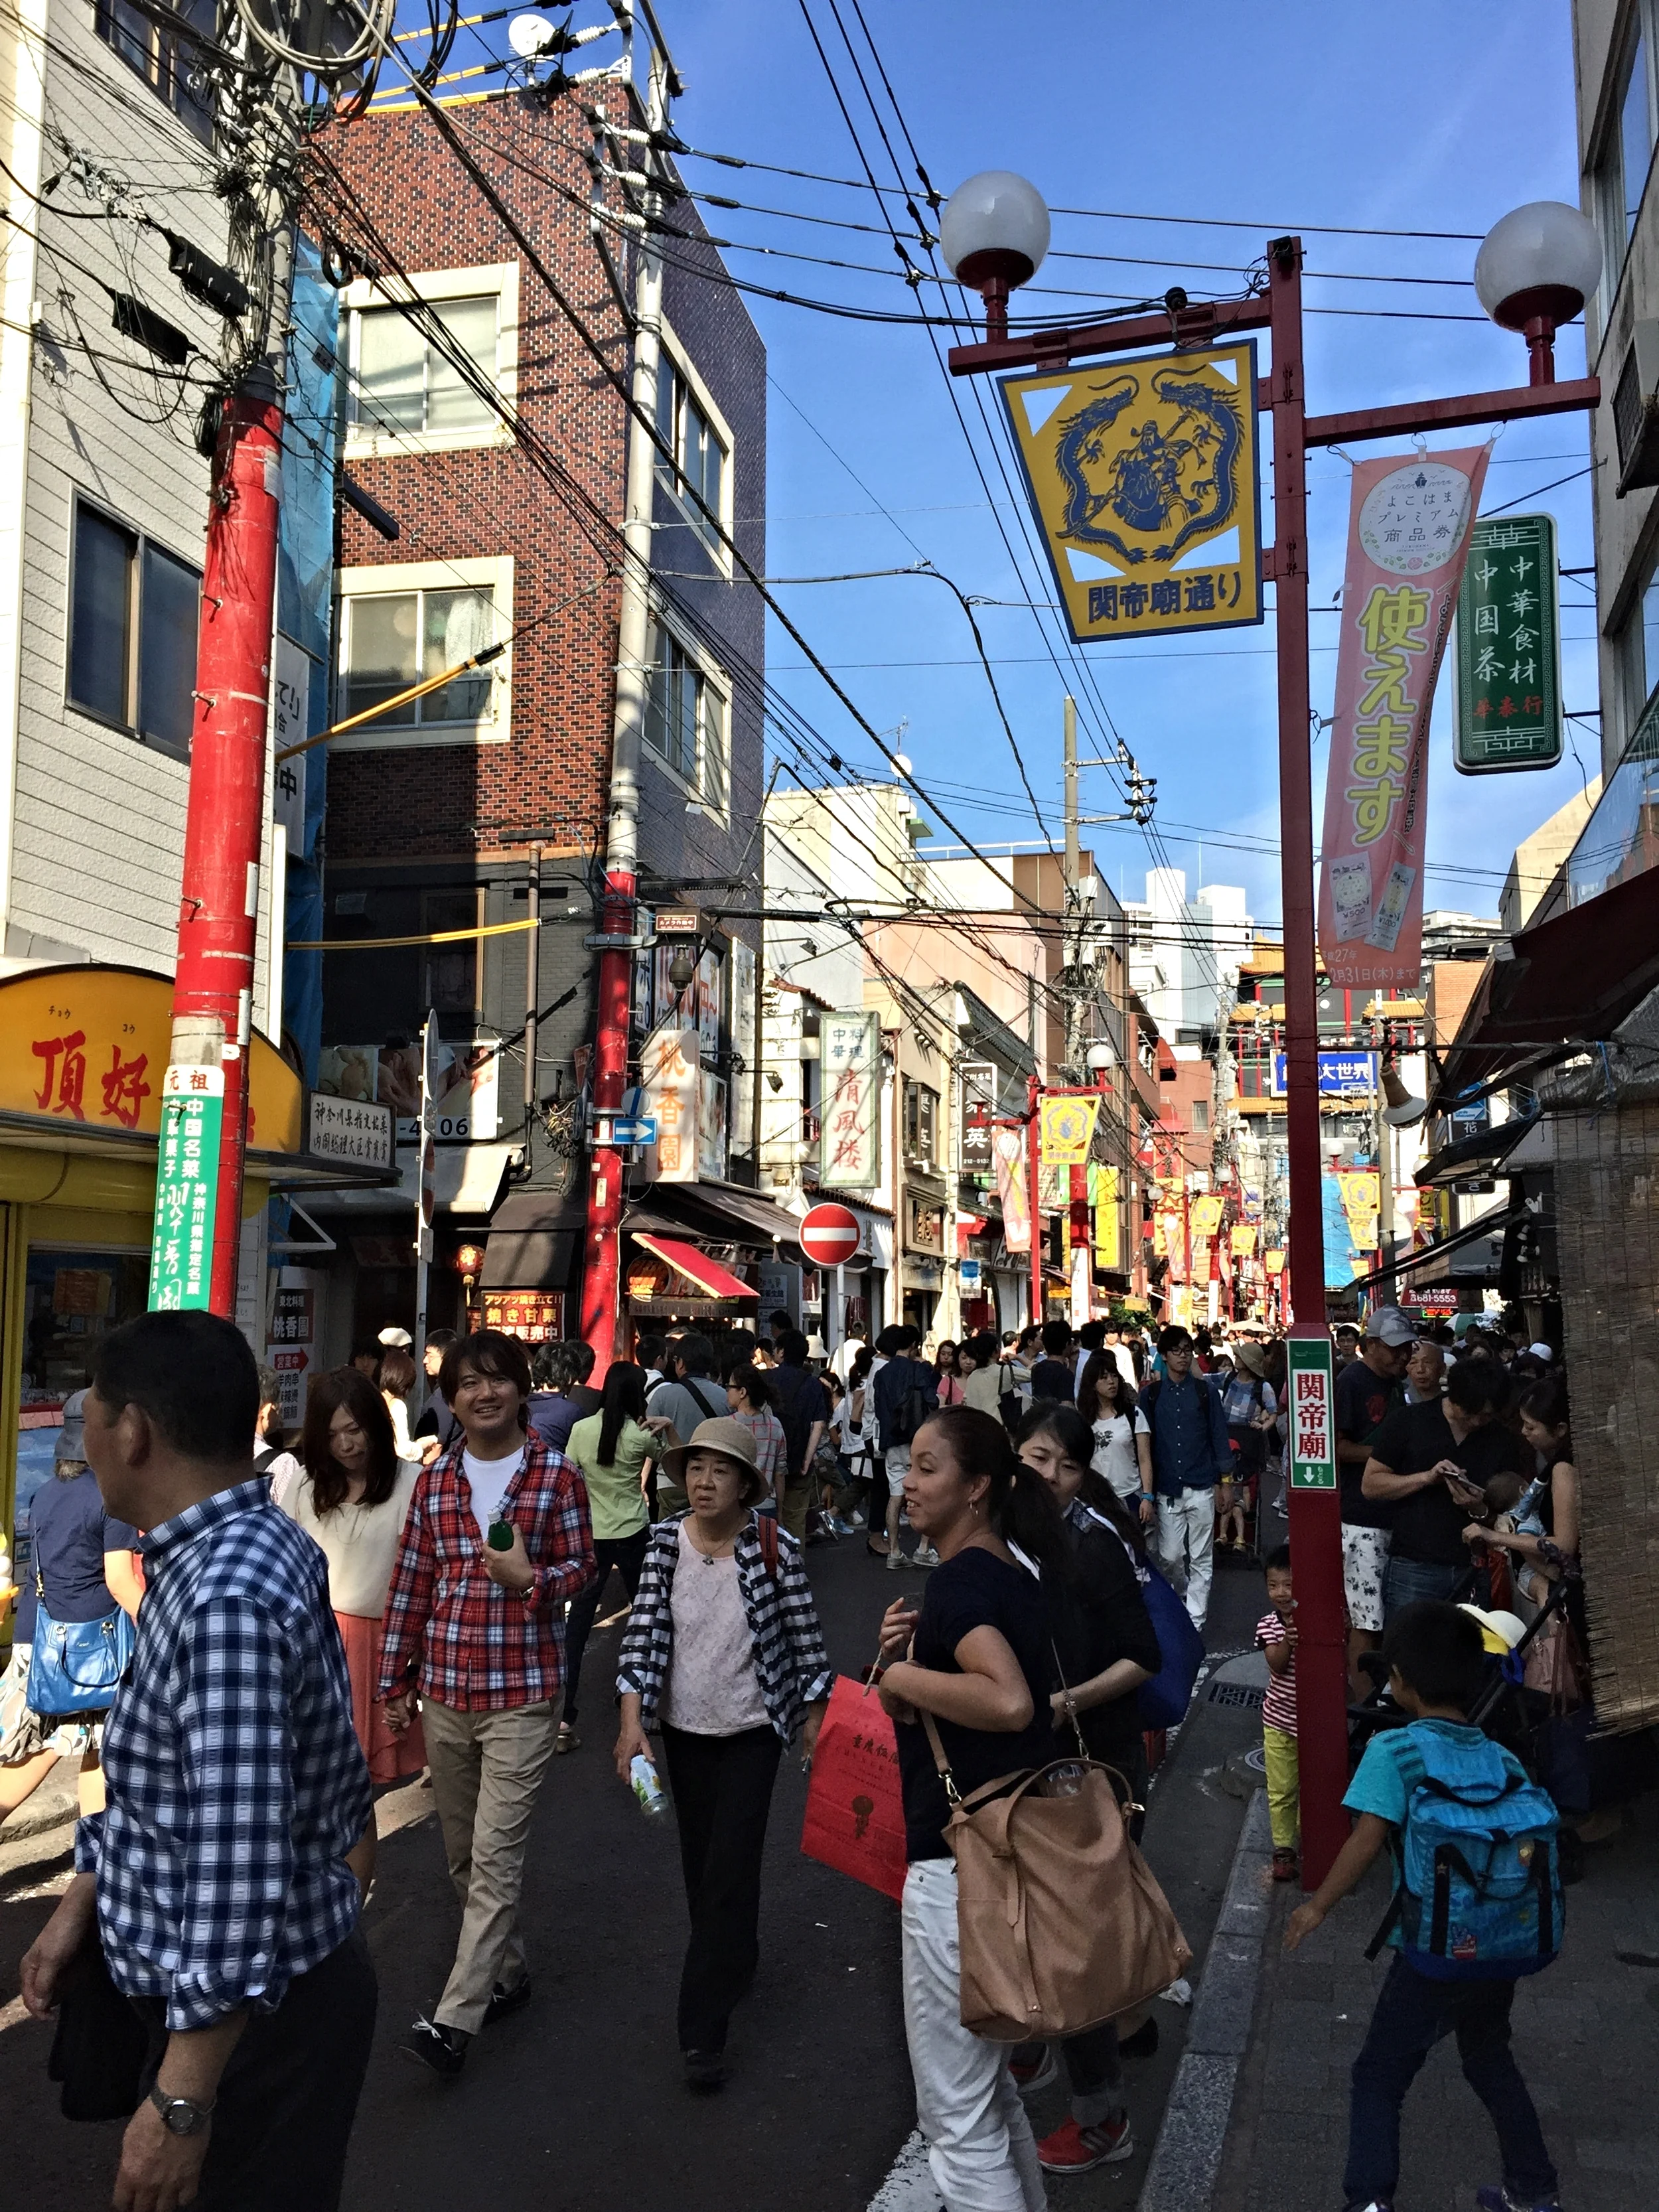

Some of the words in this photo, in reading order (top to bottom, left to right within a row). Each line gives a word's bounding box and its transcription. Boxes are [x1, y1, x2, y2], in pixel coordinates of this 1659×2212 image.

[1387, 490, 1452, 507] よこはま
[1378, 508, 1459, 524] プレミアム
[1384, 525, 1451, 543] 商品券
[1088, 571, 1241, 624] 関帝廟通り
[1473, 559, 1505, 683] 中国茶
[1506, 556, 1540, 684] 中華食材
[1348, 585, 1431, 845] 使えます
[48, 1005, 71, 1019] チョウ
[123, 1024, 135, 1034] コウ
[169, 1070, 209, 1090] 元祖
[656, 1039, 686, 1172] 桃香園
[399, 1118, 469, 1136] -406
[279, 1295, 305, 1307] 東北料理
[1416, 1294, 1457, 1303] 681-5553
[486, 1307, 557, 1323] 焼き甘栗
[273, 1315, 310, 1339] 桃香園
[277, 1355, 299, 1369] 営業中
[1297, 1373, 1327, 1459] 関帝廟
